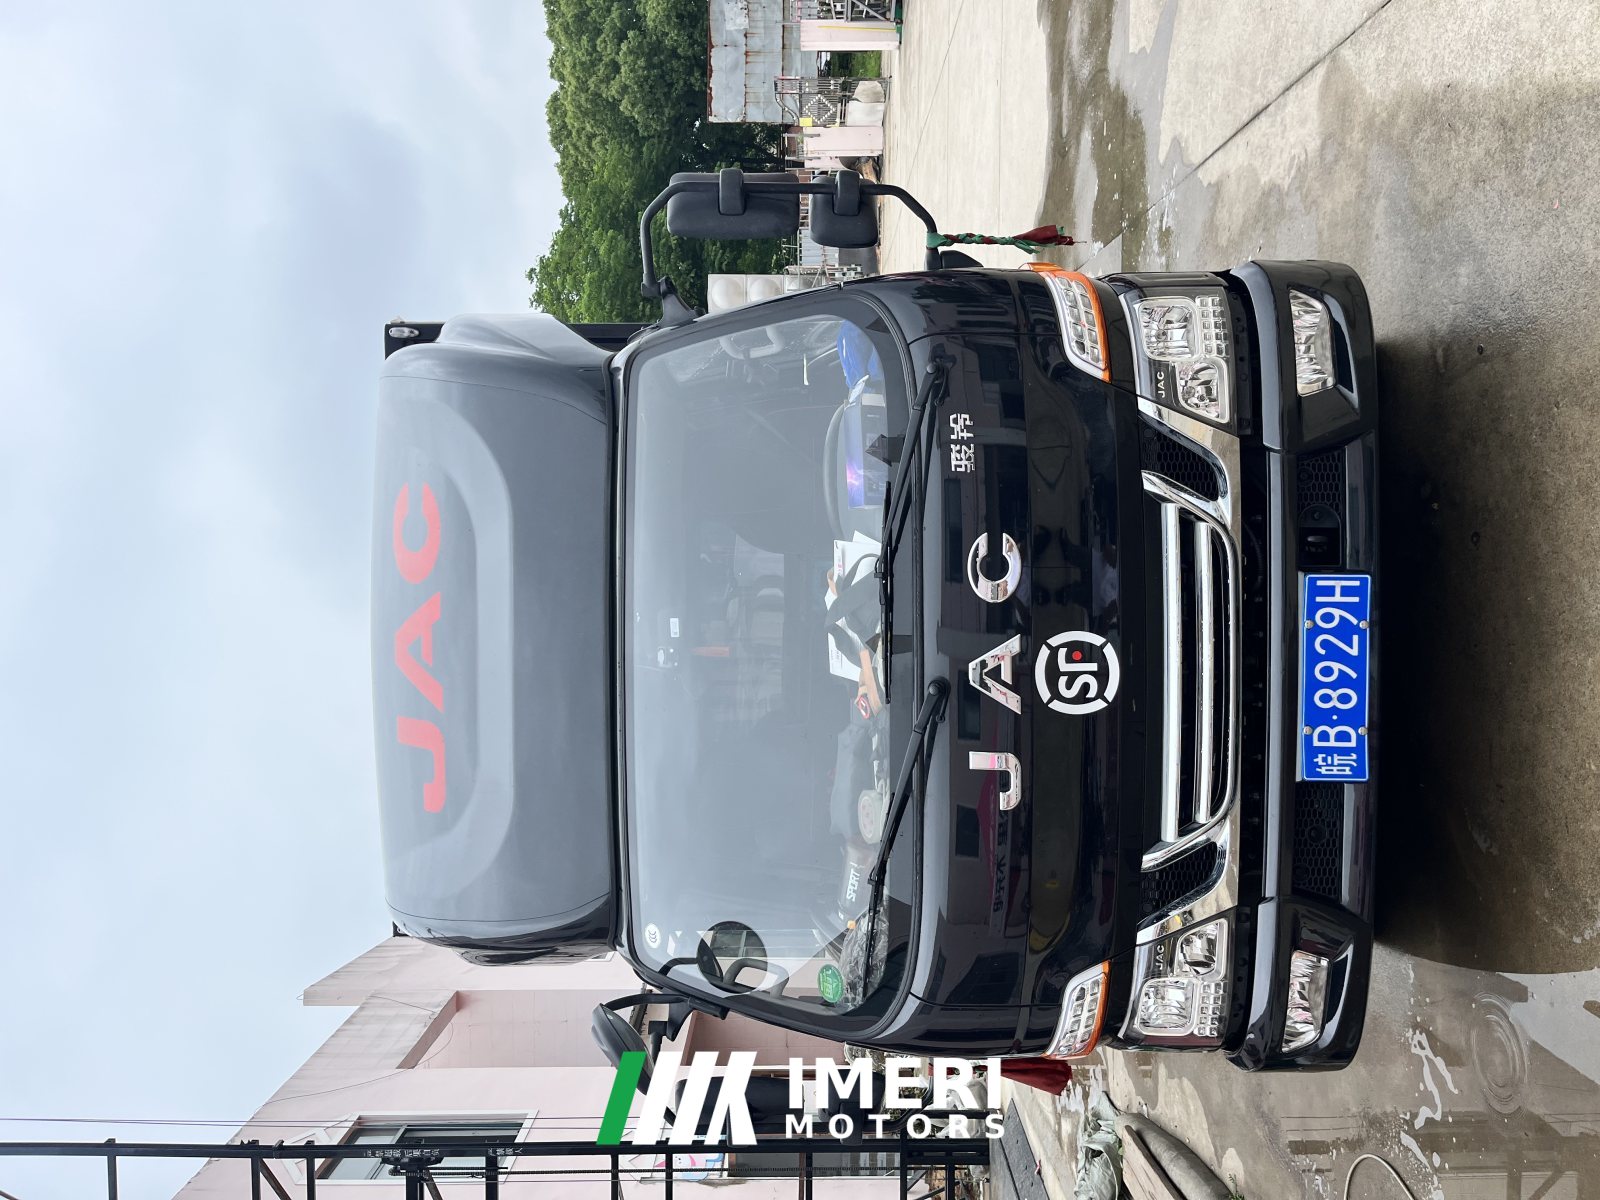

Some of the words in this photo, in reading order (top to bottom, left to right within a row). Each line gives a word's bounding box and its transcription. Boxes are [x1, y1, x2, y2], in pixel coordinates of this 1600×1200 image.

[1157, 371, 1165, 398] JAC
[949, 413, 976, 473] 骏铃
[393, 481, 446, 814] JAC
[967, 532, 1022, 811] JAC
[1156, 945, 1165, 970] JAC
